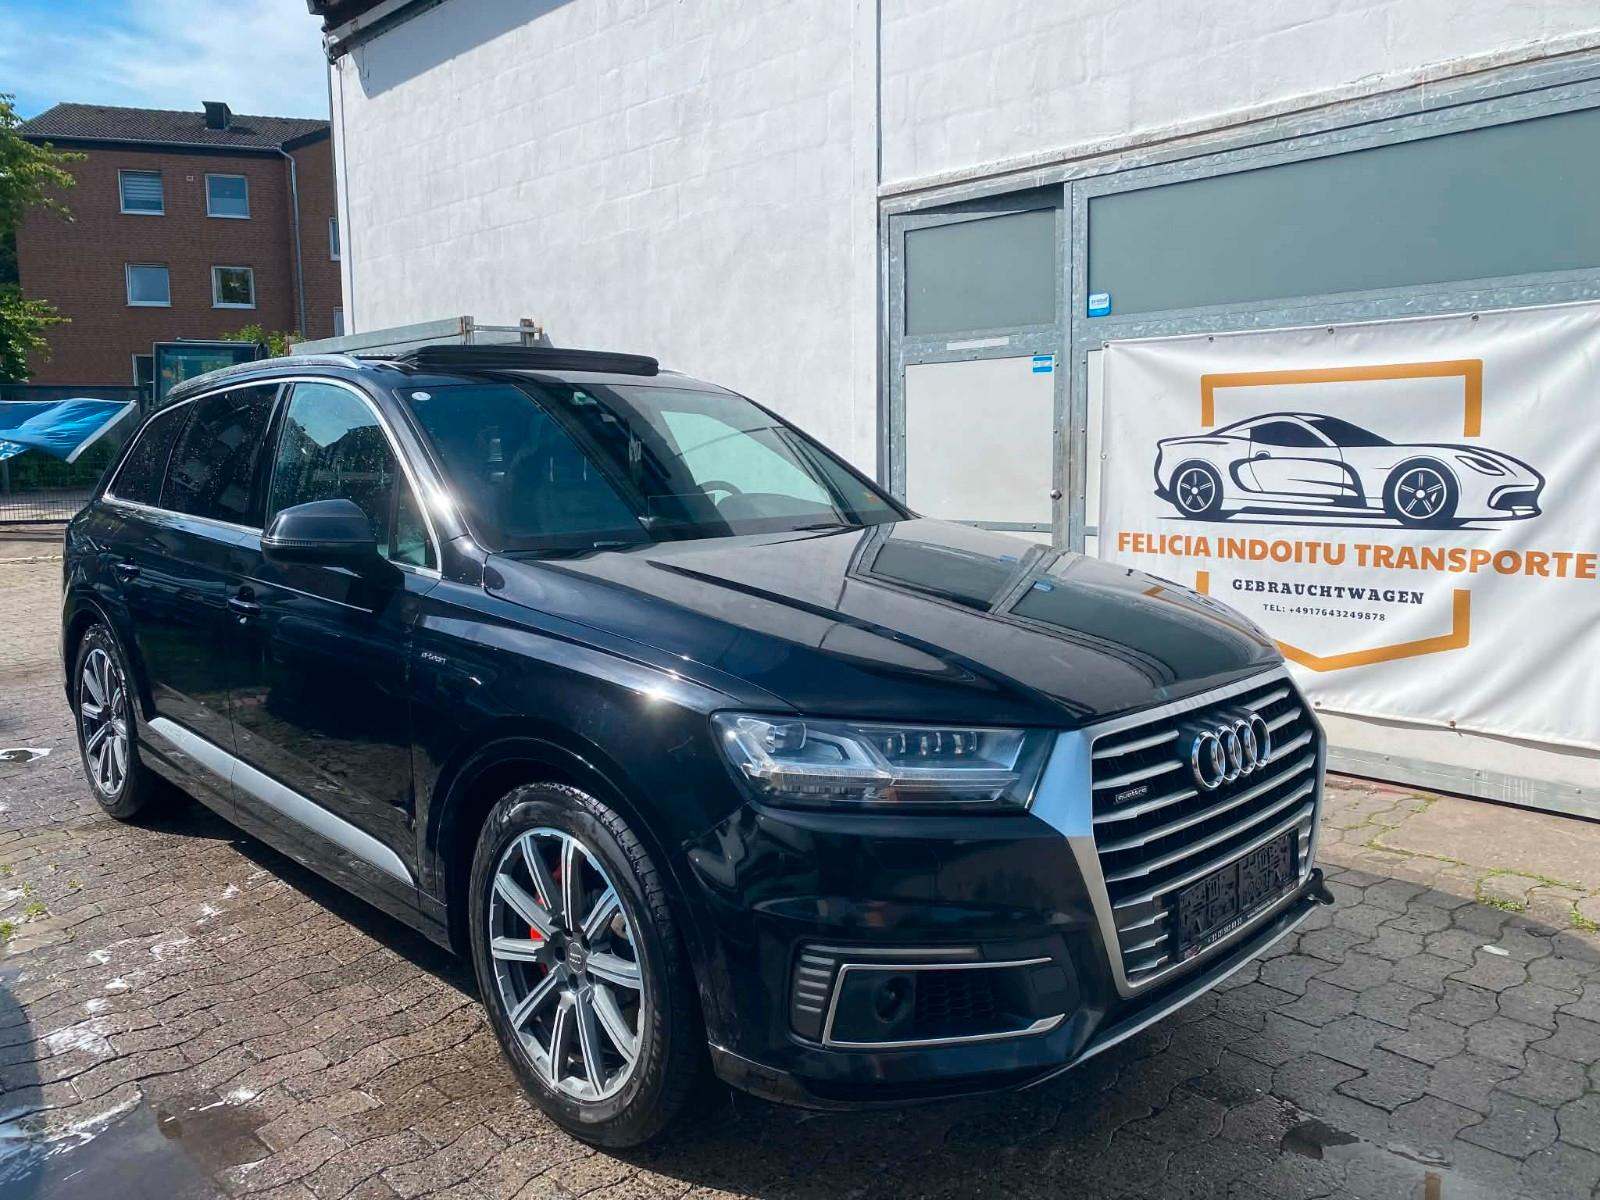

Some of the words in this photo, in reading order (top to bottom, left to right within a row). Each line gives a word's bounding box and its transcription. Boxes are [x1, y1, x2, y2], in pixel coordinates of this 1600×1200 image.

[1118, 532, 1211, 557] FELICIA
[1217, 537, 1346, 566] INDOITU
[1354, 544, 1598, 579] TRANSPORTE
[1232, 579, 1424, 604] GEBRAUCHTWAGEN
[1263, 603, 1285, 613] TEL:
[1289, 606, 1386, 621] +4917643249878
